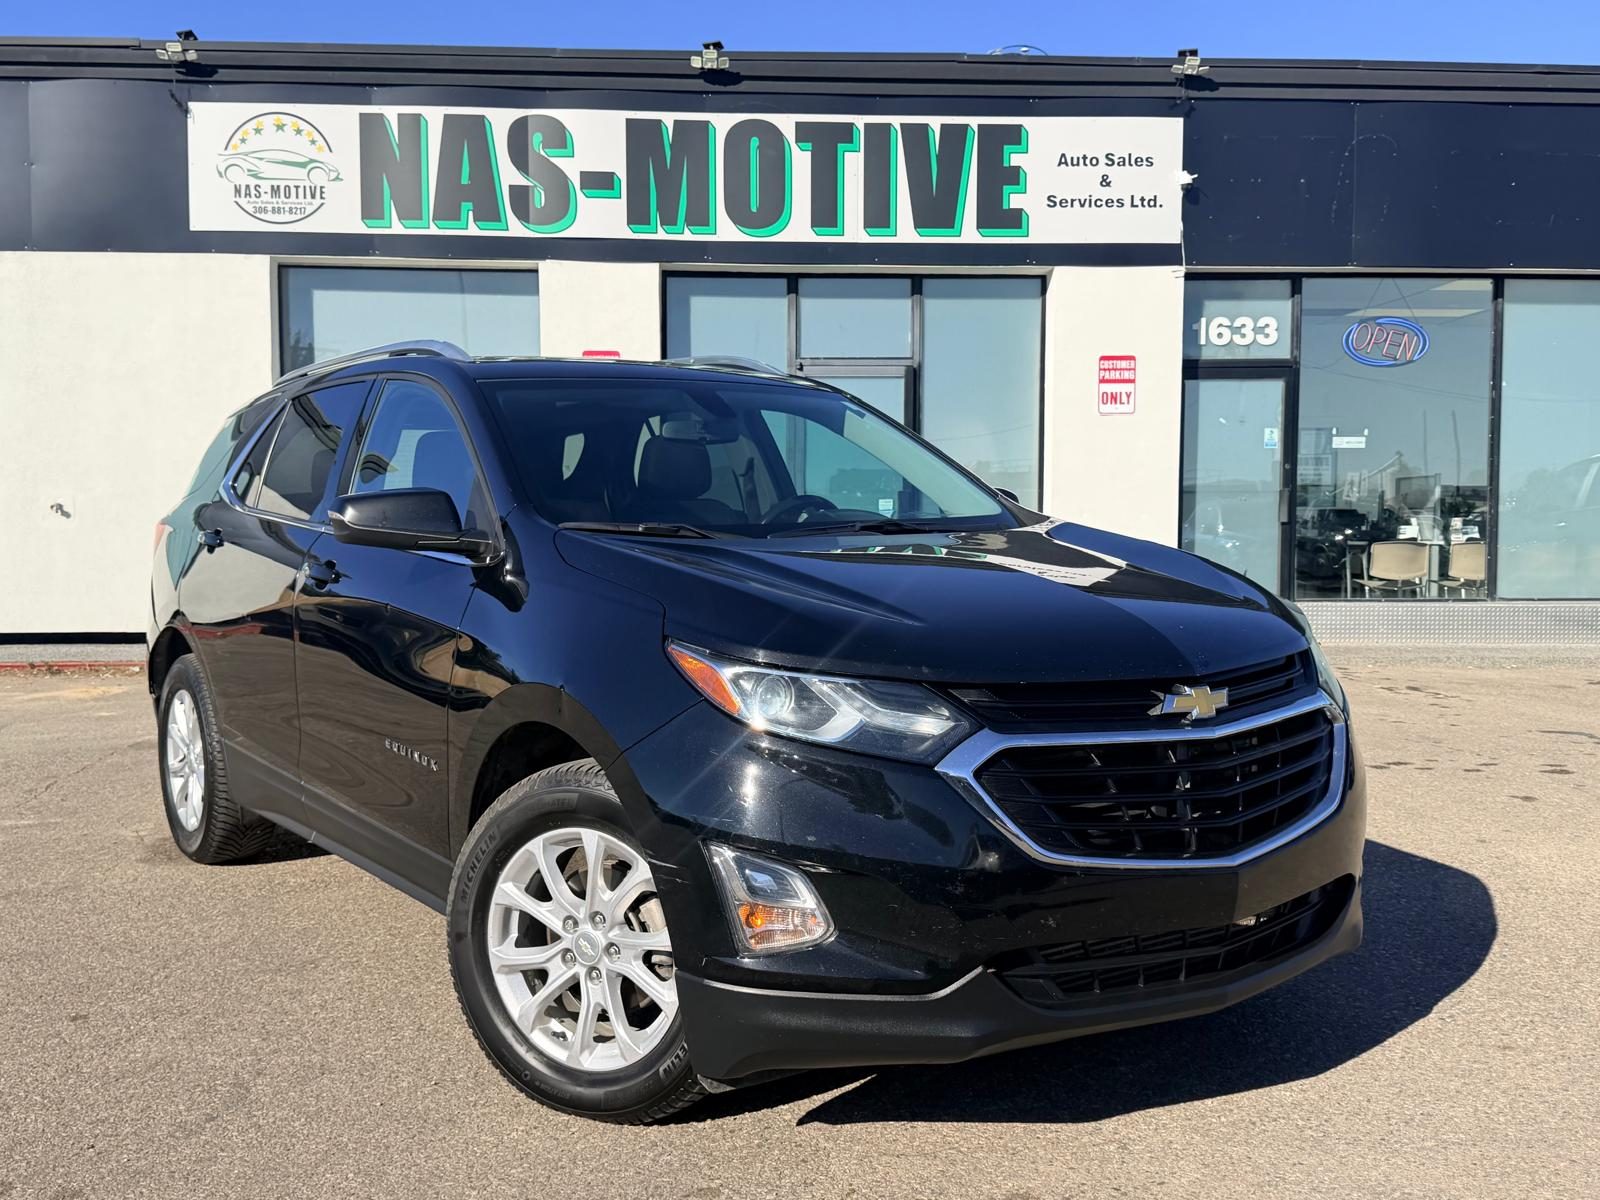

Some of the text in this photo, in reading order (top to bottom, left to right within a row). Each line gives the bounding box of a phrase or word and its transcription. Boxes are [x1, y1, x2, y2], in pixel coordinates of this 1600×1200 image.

[1057, 153, 1154, 167] Auto Sales
[359, 113, 1029, 238] NAS-MOTIVE
[1099, 174, 1112, 187] &
[234, 184, 326, 200] NAS-MOTIVE
[1046, 195, 1163, 208] Services Ltd.
[252, 205, 307, 216] 306-881-8217
[1191, 316, 1278, 346] 1633
[1354, 323, 1417, 361] OPEN
[1100, 360, 1136, 369] CUSTOMER
[1100, 370, 1136, 380] PARKING
[1101, 391, 1132, 405] ONLY
[385, 737, 440, 772] EQUINOX
[460, 830, 497, 904] MICHELIN
